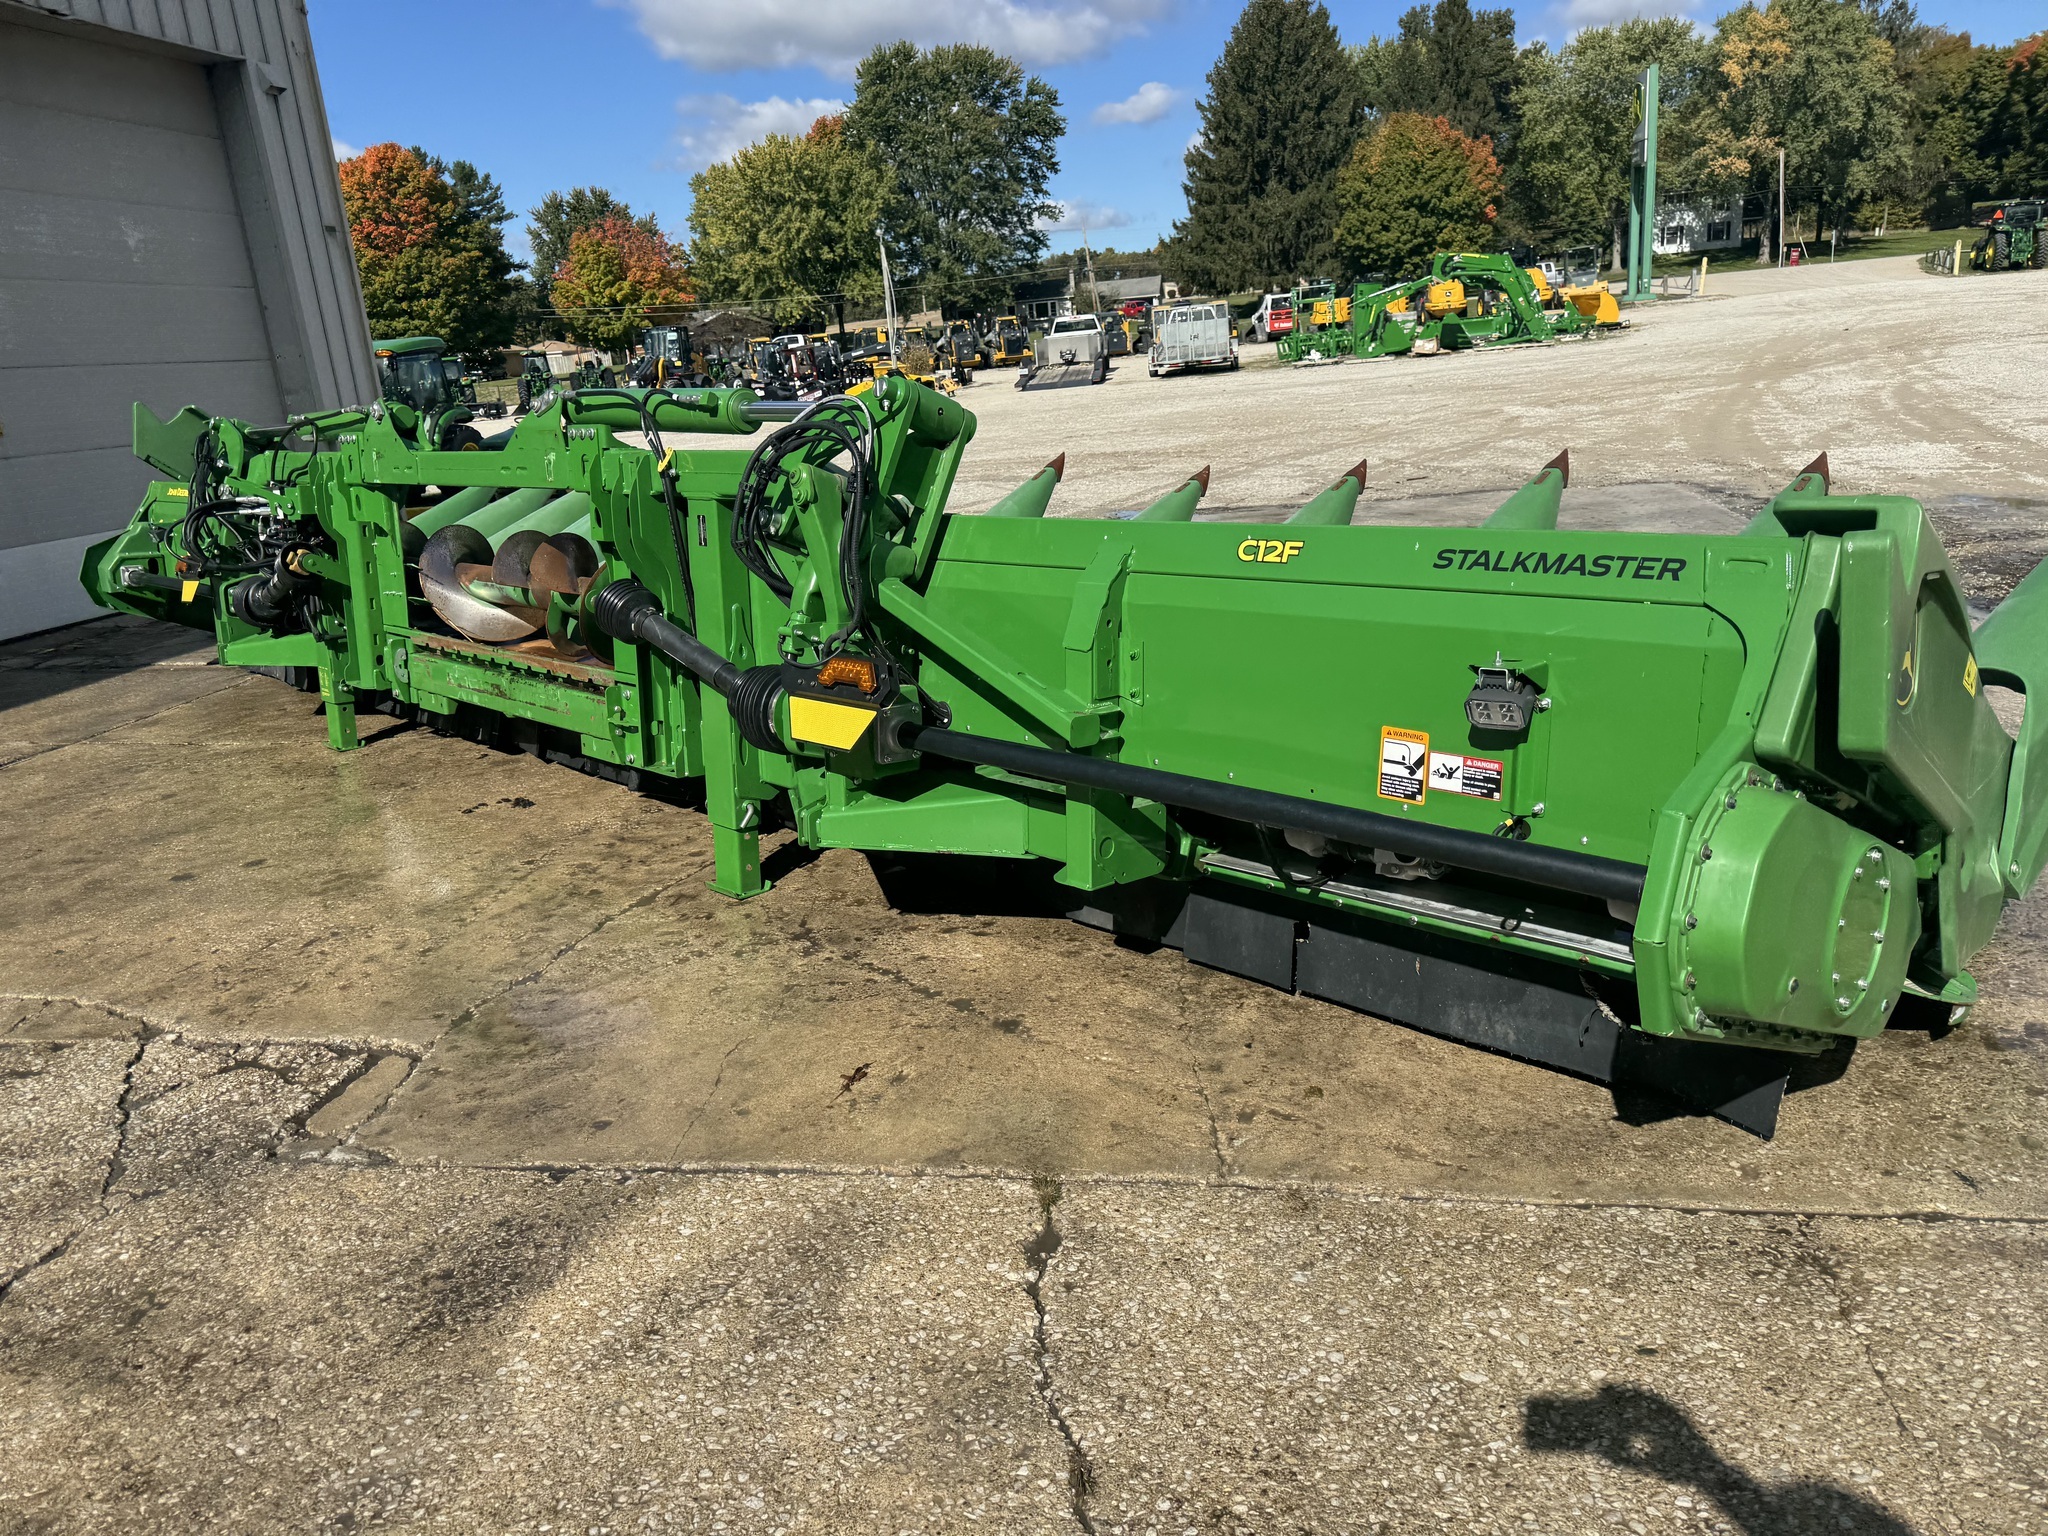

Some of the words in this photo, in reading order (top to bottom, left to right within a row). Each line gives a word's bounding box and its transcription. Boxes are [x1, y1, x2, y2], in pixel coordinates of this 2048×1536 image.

[1237, 538, 1305, 565] C12F
[1432, 548, 1687, 582] STALKMASTER
[1392, 730, 1423, 741] WARNING
[1474, 760, 1498, 770] DANGER
